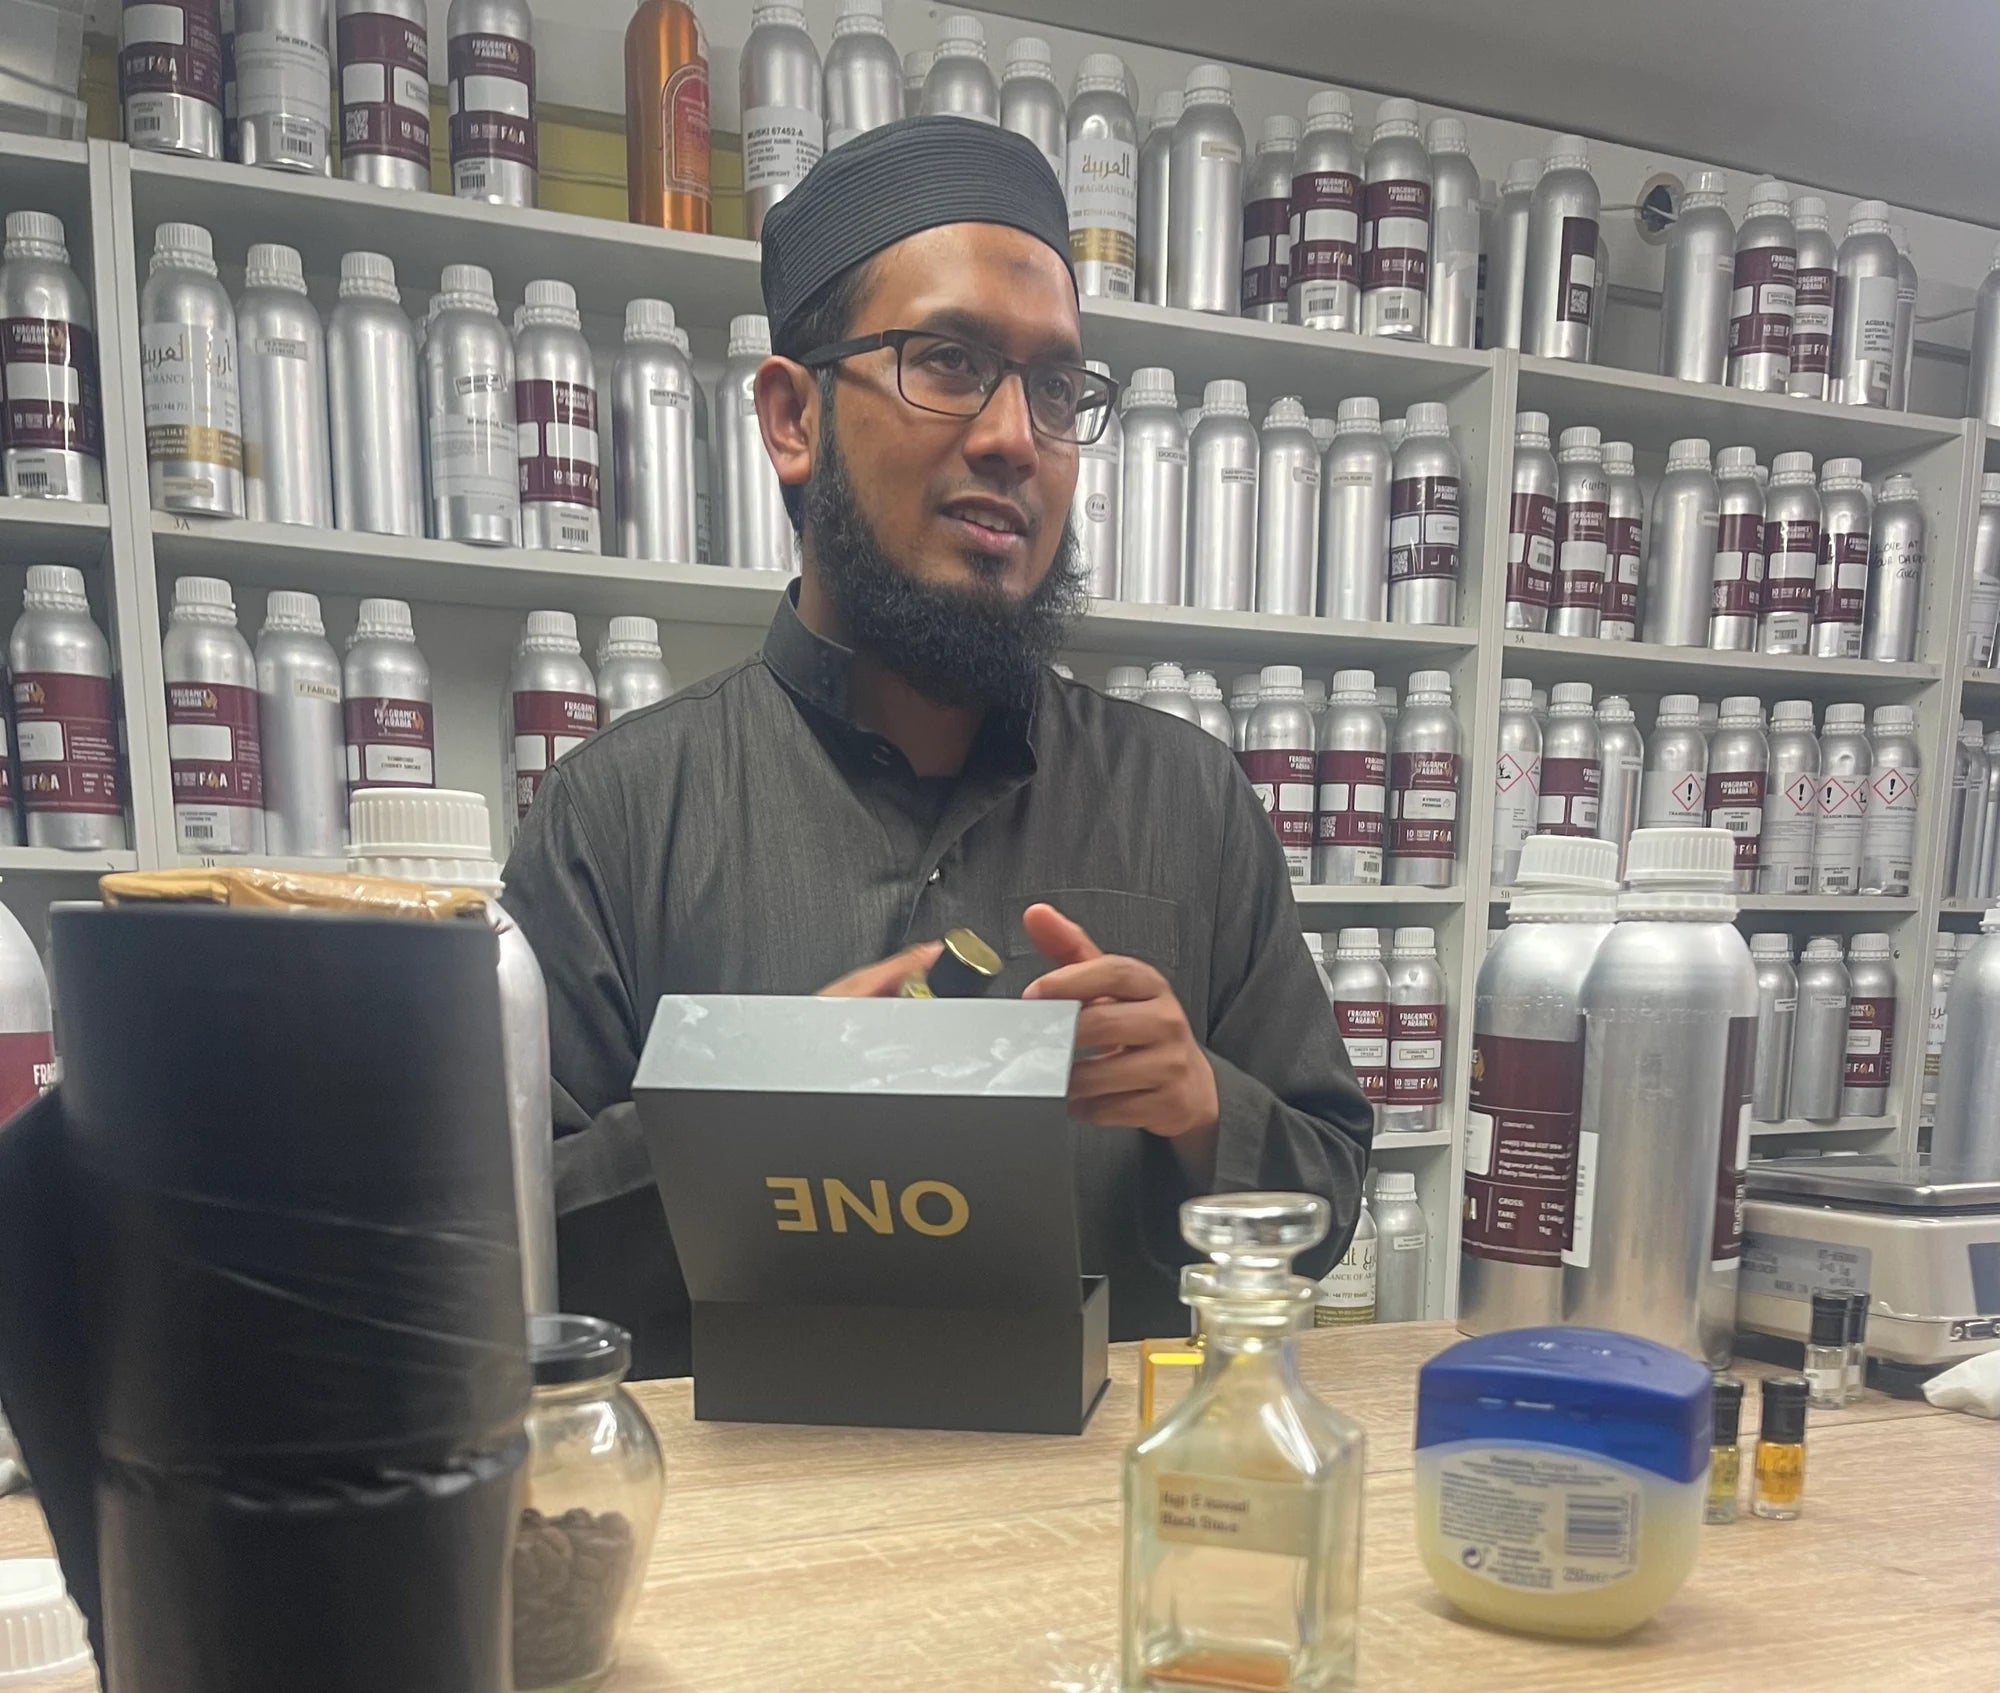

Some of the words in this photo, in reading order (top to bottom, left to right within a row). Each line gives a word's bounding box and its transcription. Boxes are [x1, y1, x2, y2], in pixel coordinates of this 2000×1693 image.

[1347, 1009, 1380, 1019] FRAGRANCE
[1400, 1012, 1433, 1022] FRAGRANCE
[1355, 1016, 1376, 1025] ARABIA
[1407, 1019, 1429, 1027] ARABIA
[766, 1177, 970, 1237] ONE
